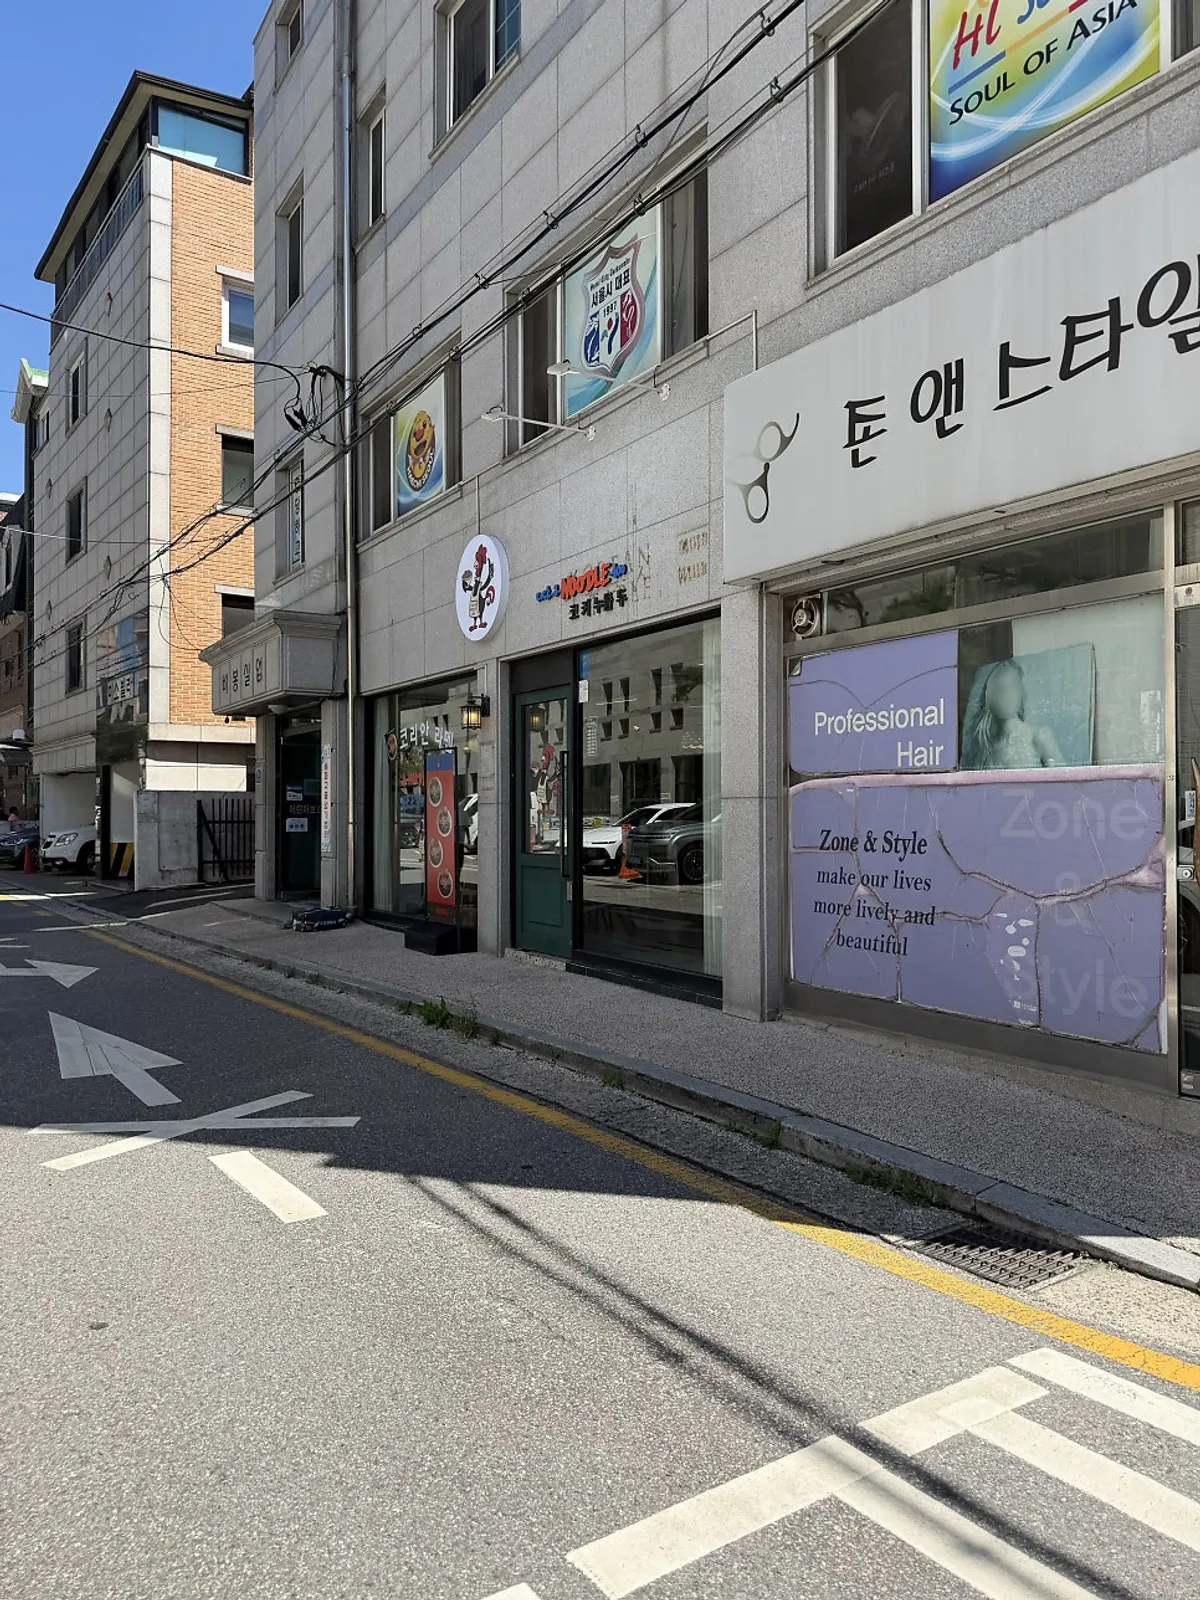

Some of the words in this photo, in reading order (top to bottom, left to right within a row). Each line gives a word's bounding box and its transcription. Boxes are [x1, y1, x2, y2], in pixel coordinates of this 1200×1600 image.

[949, 72, 1015, 125] SOUL
[1023, 39, 1058, 75] OF
[1066, 0, 1138, 50] ASIA
[591, 281, 613, 308] 서울시
[615, 269, 630, 291] 대표
[603, 301, 617, 317] 1997
[910, 358, 964, 439] 앤
[560, 560, 612, 600] NOODLE
[814, 698, 944, 735] Professional
[399, 720, 430, 750] 코리안
[897, 739, 944, 767] Hair
[1000, 788, 1148, 841] Zone
[818, 829, 859, 851] Zone
[863, 830, 878, 853] &
[882, 830, 927, 862] Style
[817, 866, 856, 885] make
[861, 873, 888, 888] our
[893, 869, 932, 891] lives
[813, 900, 852, 917] more
[856, 899, 899, 927] lively
[904, 905, 936, 926] and
[836, 928, 907, 956] beautiful
